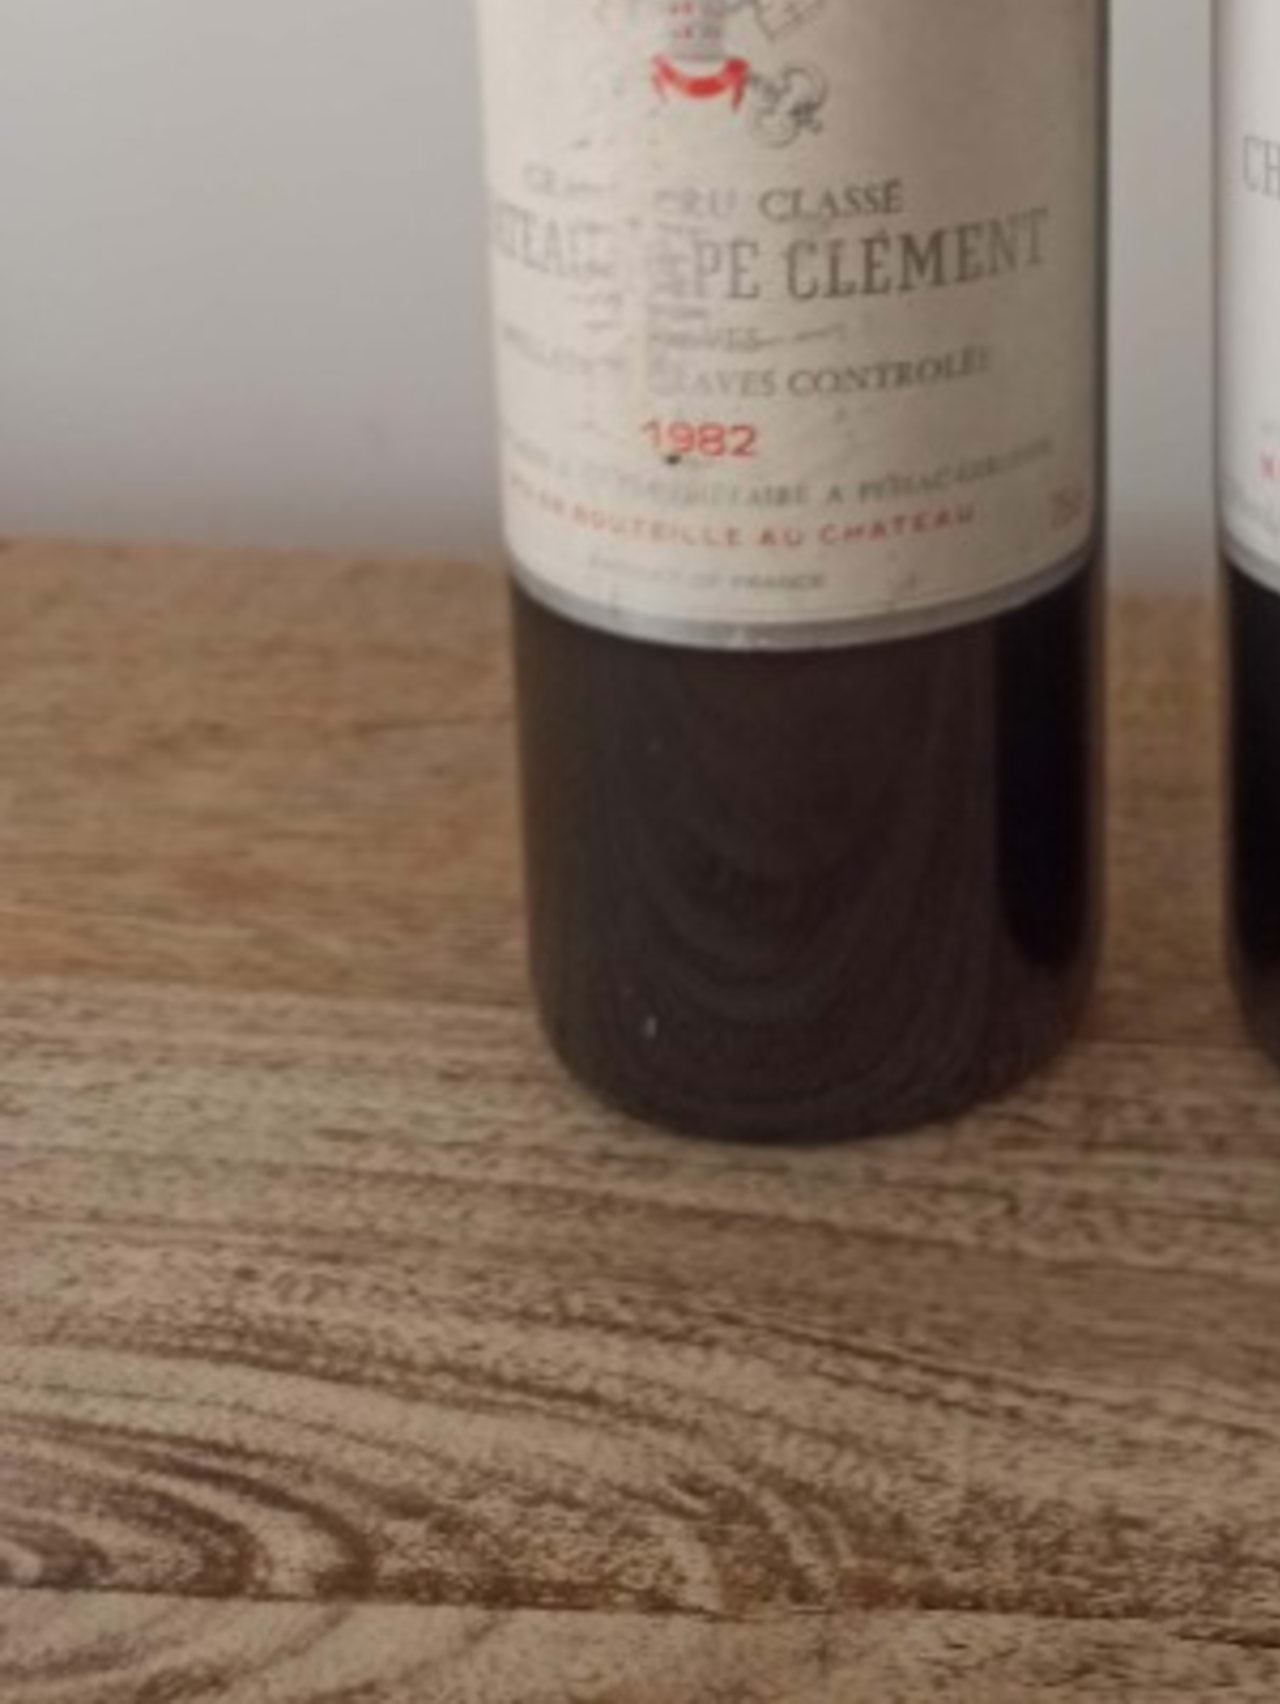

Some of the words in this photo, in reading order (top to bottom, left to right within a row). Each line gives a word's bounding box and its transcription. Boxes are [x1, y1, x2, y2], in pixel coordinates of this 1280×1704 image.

[639, 417, 760, 459] 1982
[756, 526, 806, 548] AU
[818, 500, 977, 547] CHATEAU
